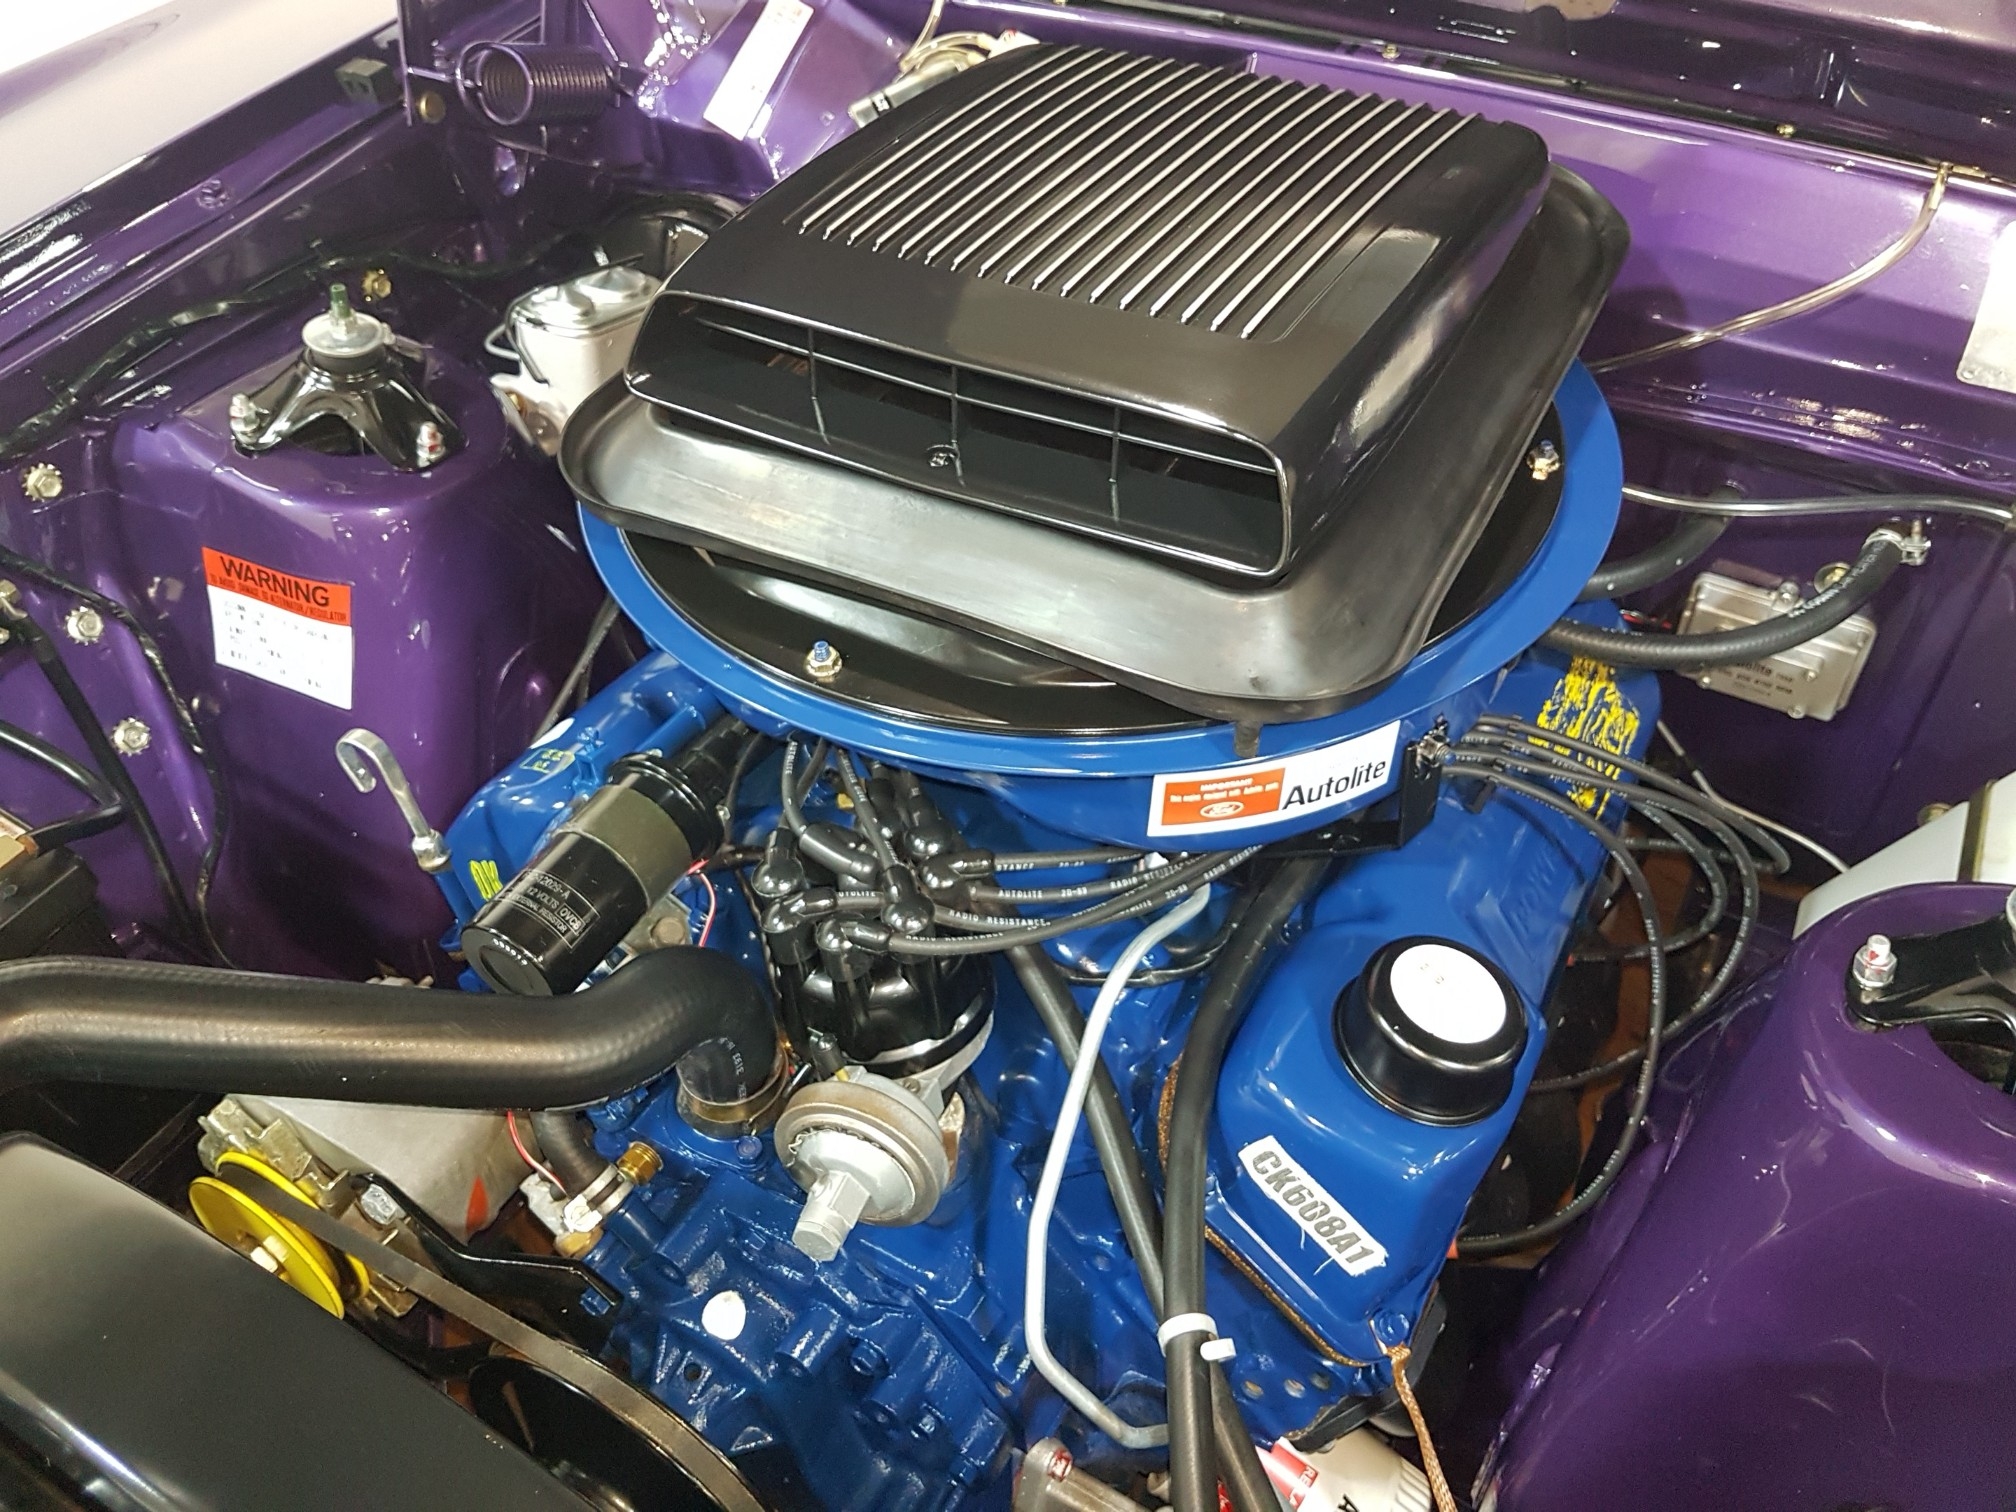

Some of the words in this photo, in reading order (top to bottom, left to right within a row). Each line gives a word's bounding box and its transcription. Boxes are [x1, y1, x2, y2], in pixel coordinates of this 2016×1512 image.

[220, 555, 330, 607] WARNING
[1282, 760, 1387, 810] Autolite
[536, 891, 560, 909] VOLTS
[997, 889, 1043, 898] AUTOLITE
[538, 904, 568, 934] RESISTOR
[949, 909, 979, 922] RADIO
[1252, 1150, 1375, 1264] CK608A1
